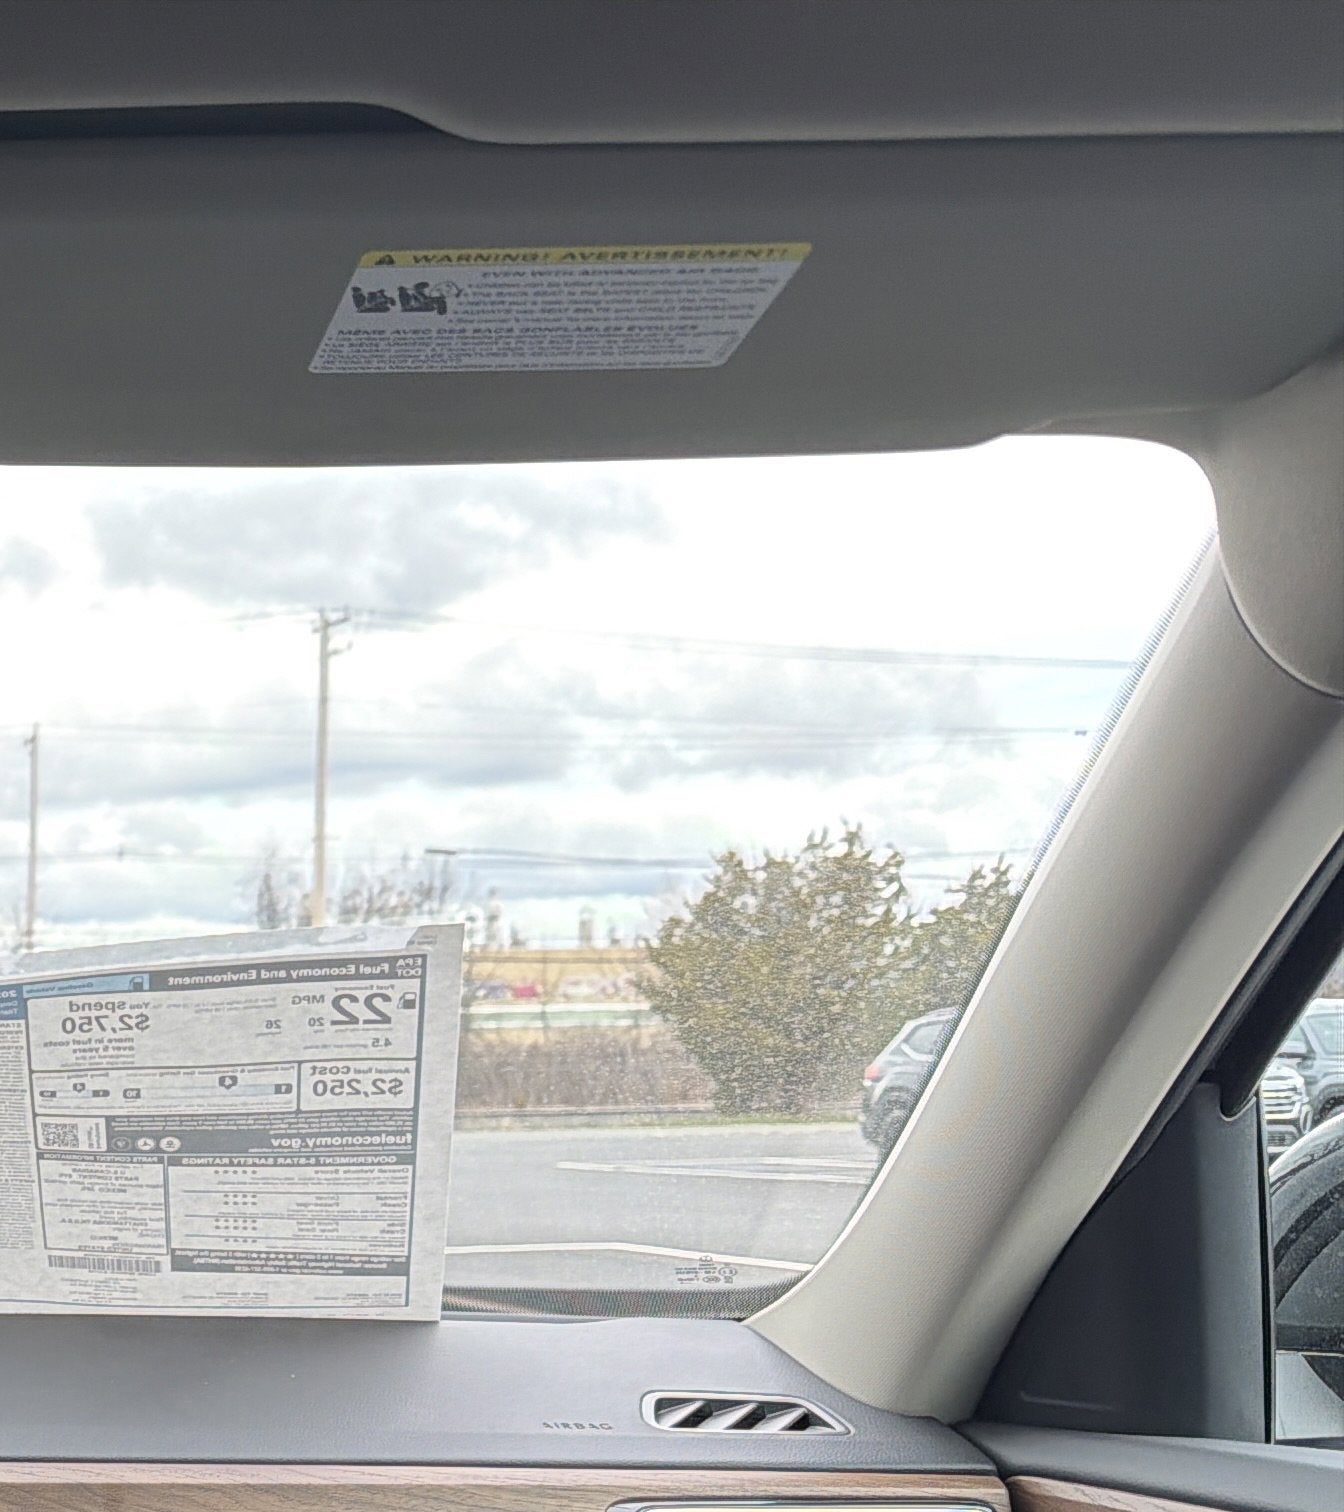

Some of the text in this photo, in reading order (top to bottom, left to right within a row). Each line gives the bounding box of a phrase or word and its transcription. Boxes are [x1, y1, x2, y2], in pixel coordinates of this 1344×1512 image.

[412, 248, 788, 264] WARNING! AVERTISSEMENT!
[542, 1421, 613, 1431] AIRBAG
